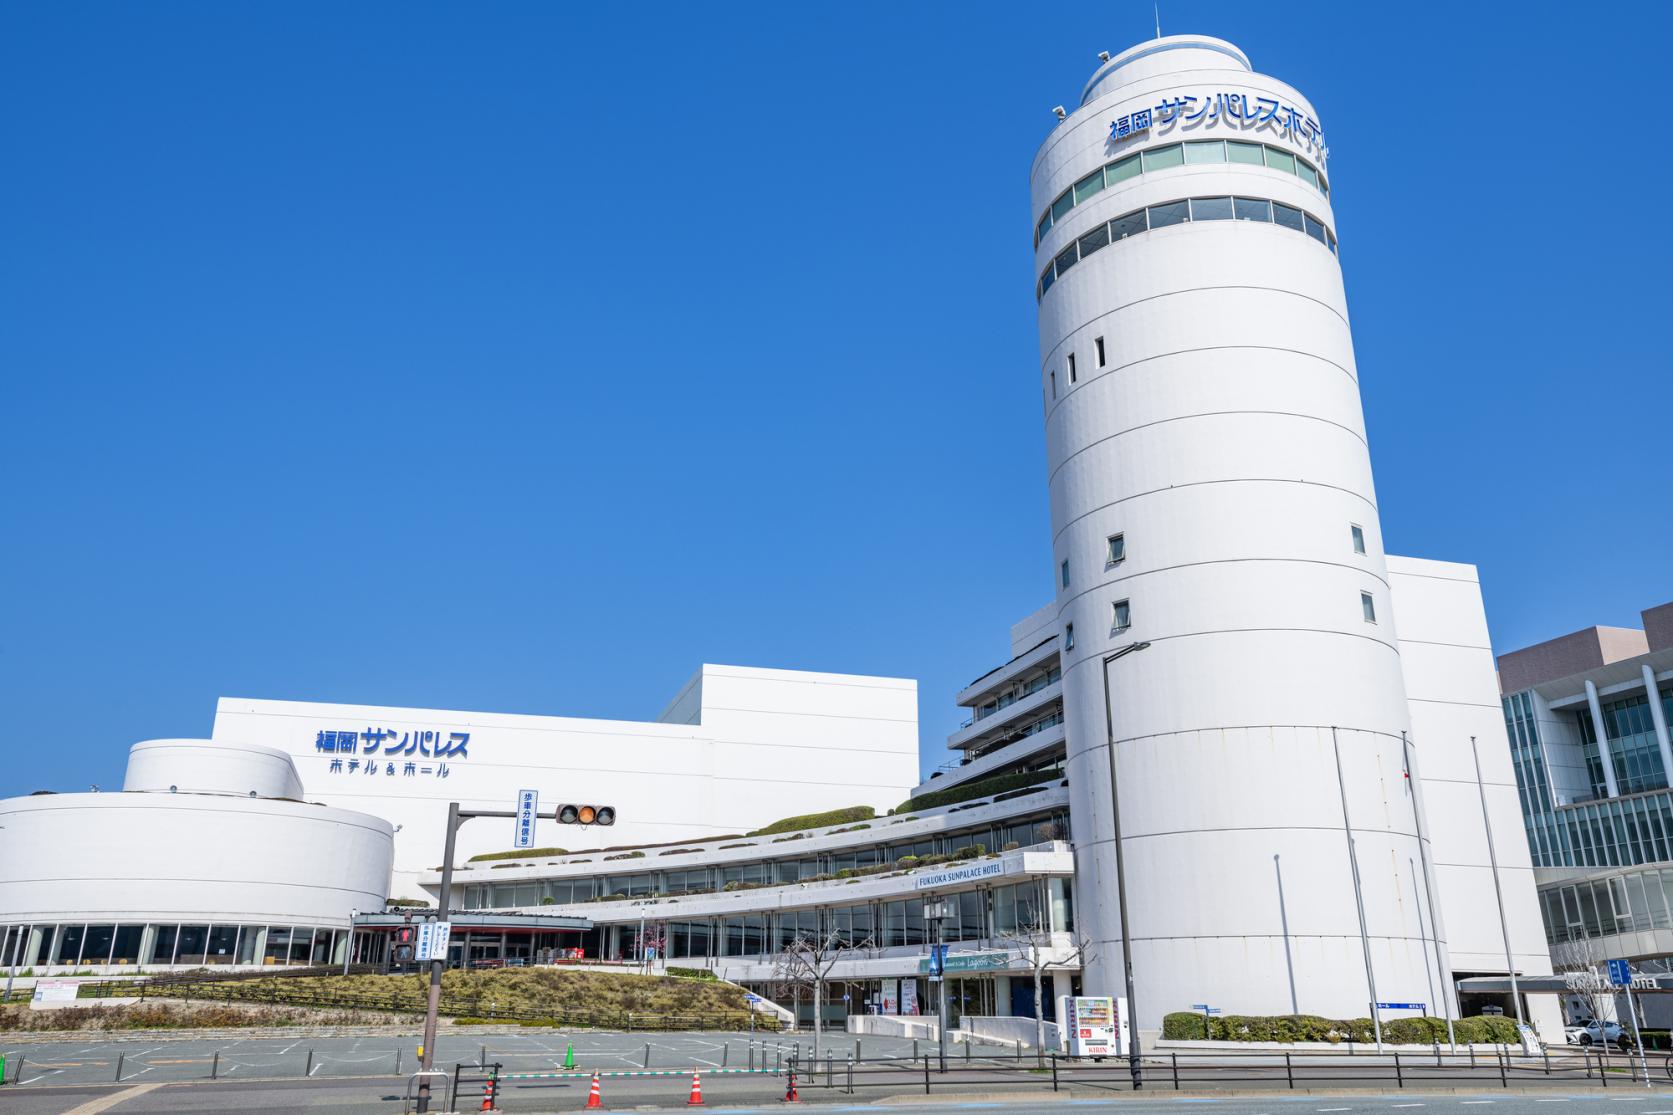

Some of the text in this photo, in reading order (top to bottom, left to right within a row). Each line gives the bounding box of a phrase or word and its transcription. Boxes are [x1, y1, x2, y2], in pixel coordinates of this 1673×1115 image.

[316, 727, 470, 758] 福岡サンパレス
[521, 793, 533, 846] 歩車分離信号
[919, 864, 1001, 886] FUKUOKA SUNPALACE HOTEL
[1069, 1000, 1077, 1039] KIRIN
